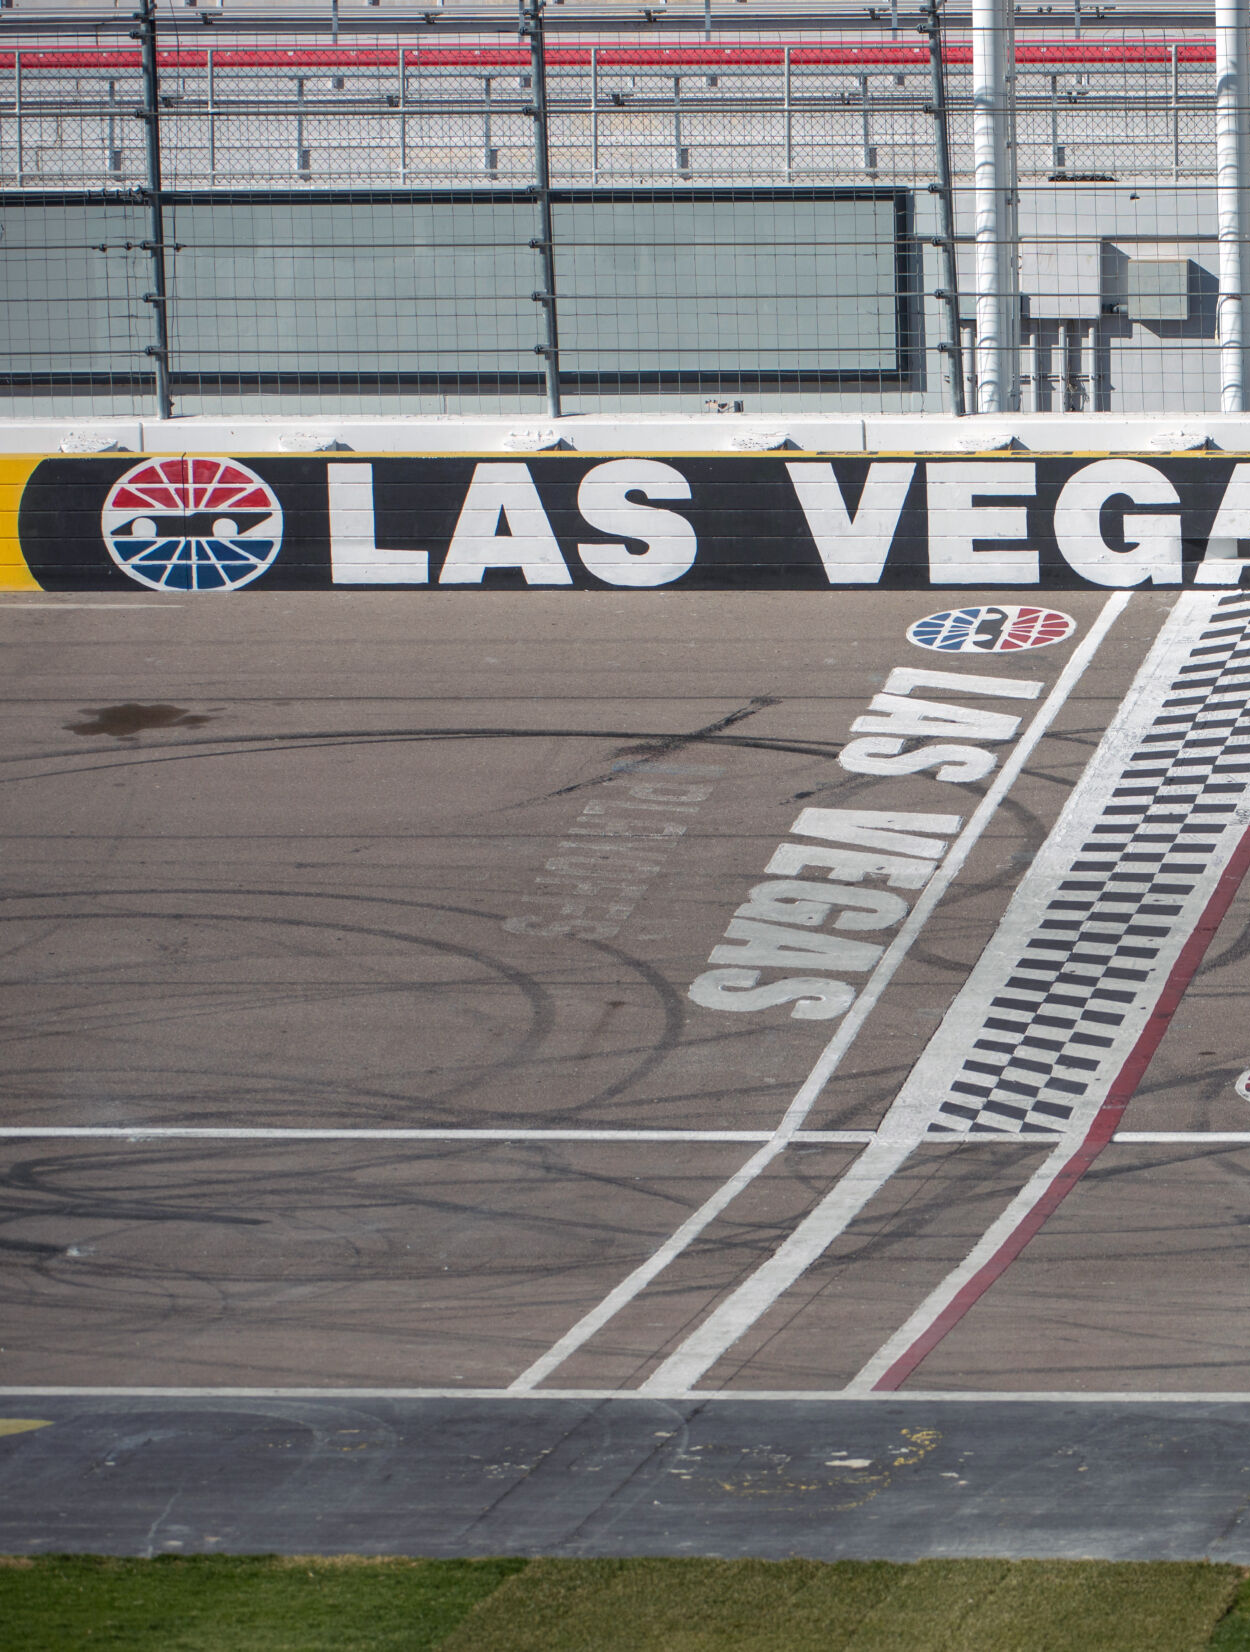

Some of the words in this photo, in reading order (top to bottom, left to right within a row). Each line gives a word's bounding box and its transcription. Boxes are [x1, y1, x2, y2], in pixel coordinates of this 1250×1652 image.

[327, 458, 698, 587] LAS
[836, 666, 1045, 784] LAS
[687, 806, 963, 1021] VEGAS
